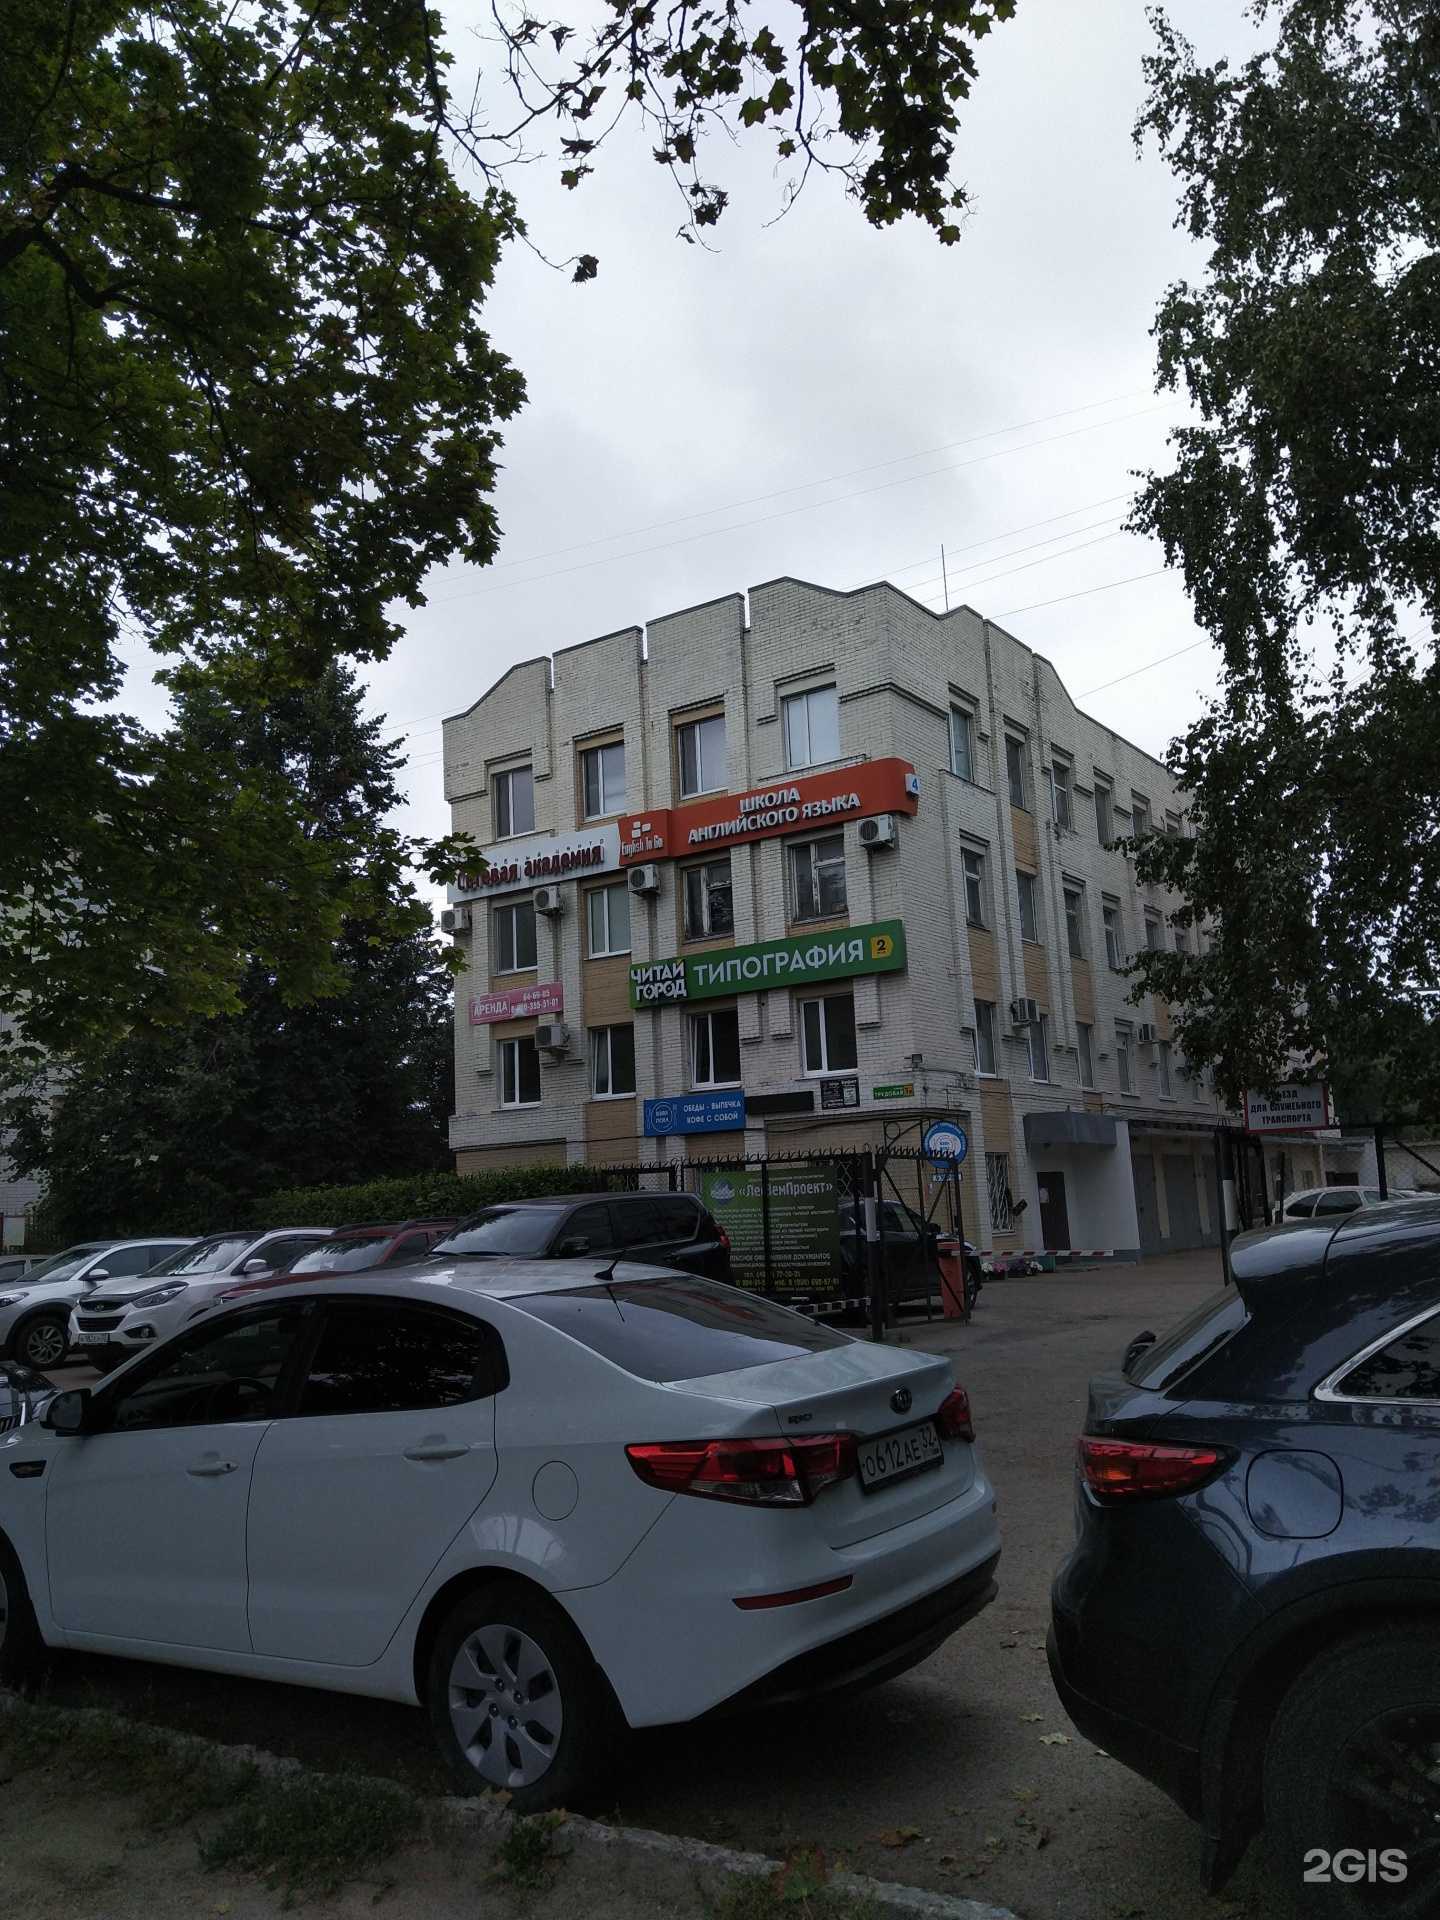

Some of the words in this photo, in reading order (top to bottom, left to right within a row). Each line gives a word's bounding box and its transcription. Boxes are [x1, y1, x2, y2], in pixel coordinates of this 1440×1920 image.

[912, 778, 919, 791] 4
[740, 787, 801, 812] ШКОЛА
[687, 804, 799, 845] АНГЛИЙСКОГО
[801, 791, 862, 819] ЯЗЫКА
[524, 845, 605, 879] академия
[876, 939, 887, 951] 2
[630, 959, 685, 984] ЧИТАЙ
[692, 938, 865, 987] ТИПОГРАФИЯ
[635, 978, 688, 1002] ГОРОД
[474, 1000, 508, 1018] АРЕНДА
[683, 1103, 705, 1114] ОБЕДЫ
[711, 1100, 742, 1111] ВЫПЕЧКА
[1250, 1103, 1267, 1113] ДЛЯ
[1269, 1100, 1321, 1112] СЛУЖЕБНОГО
[687, 1114, 705, 1125] КОФЕ
[707, 1114, 712, 1123] С
[714, 1111, 739, 1122] СОБОЙ
[1262, 1113, 1312, 1124] ТРАНСПОРТА
